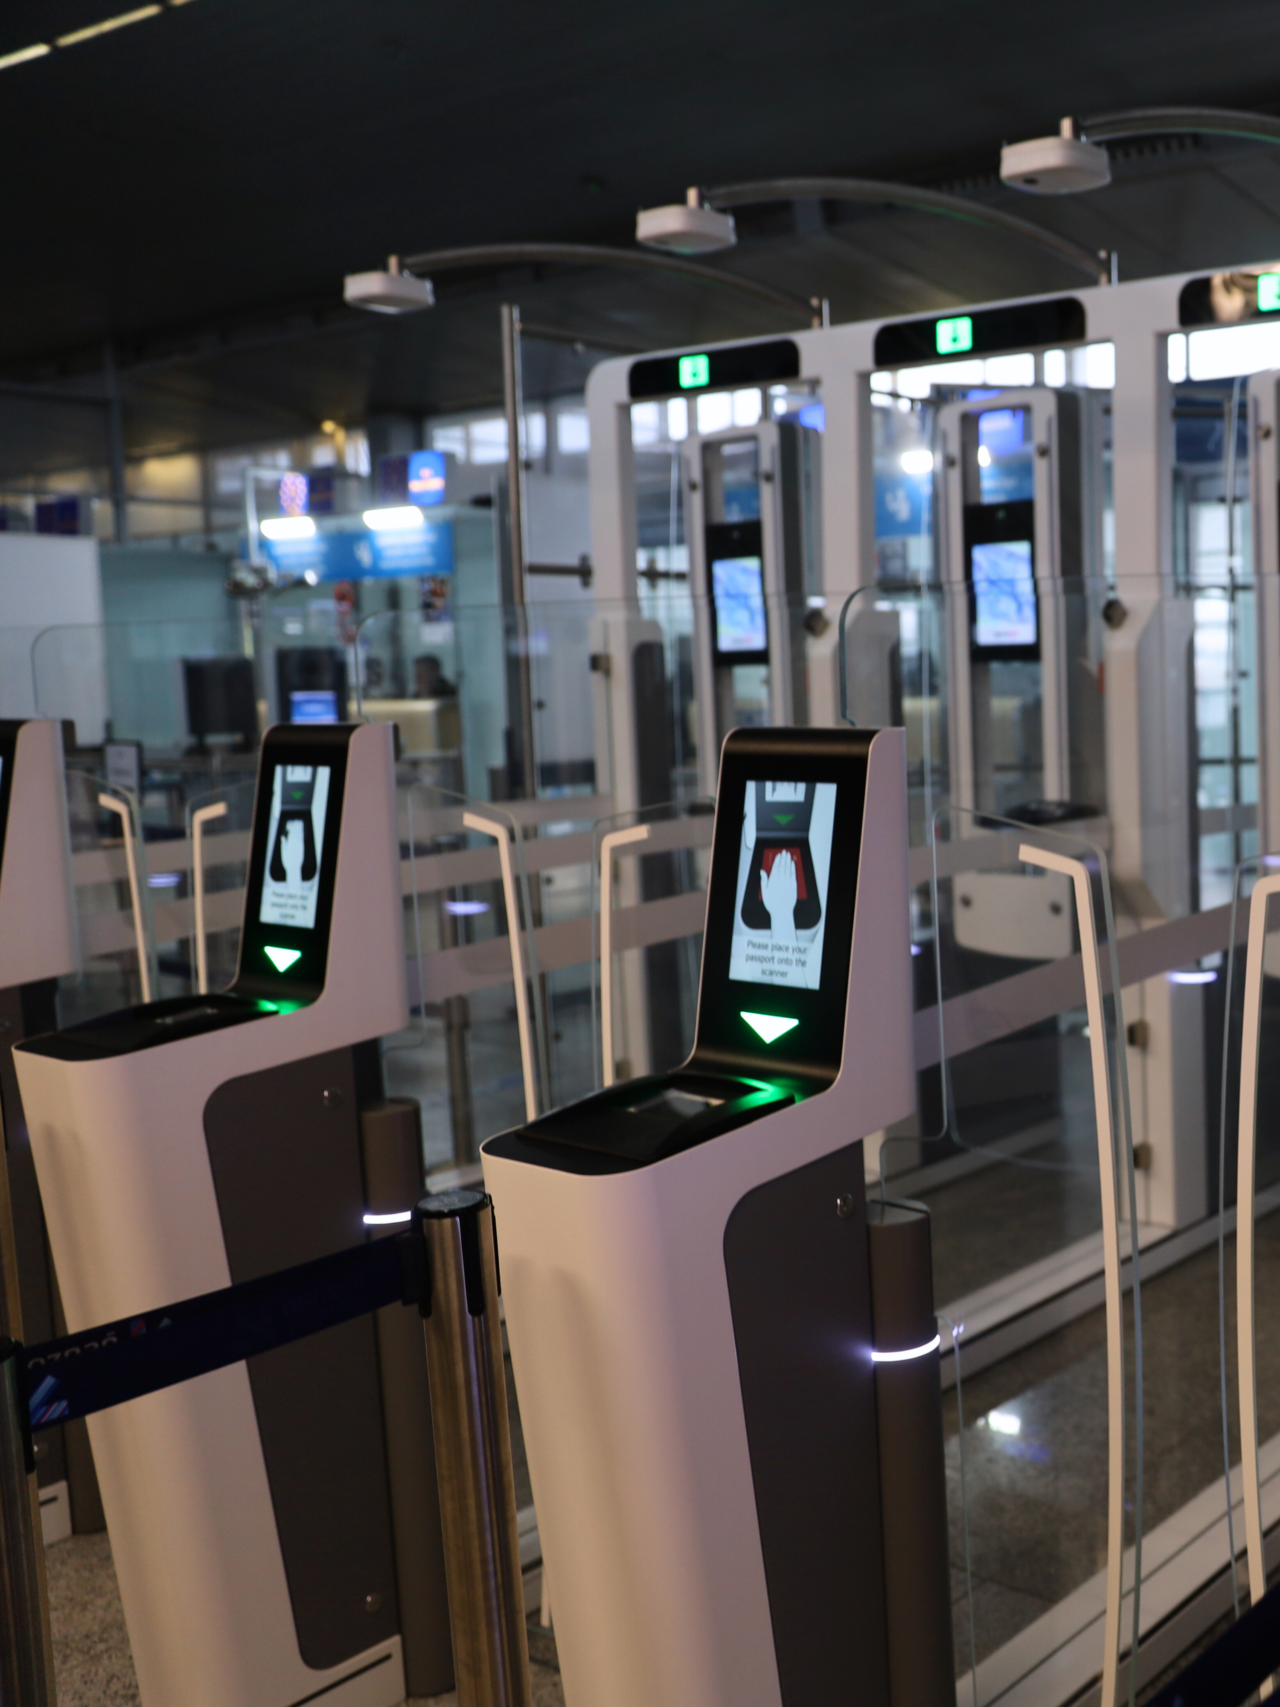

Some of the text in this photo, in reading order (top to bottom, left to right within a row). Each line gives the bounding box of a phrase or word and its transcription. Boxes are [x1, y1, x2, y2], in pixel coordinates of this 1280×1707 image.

[747, 940, 807, 955] Please place your
[745, 954, 807, 967] passport onto the
[761, 969, 788, 978] scanner
